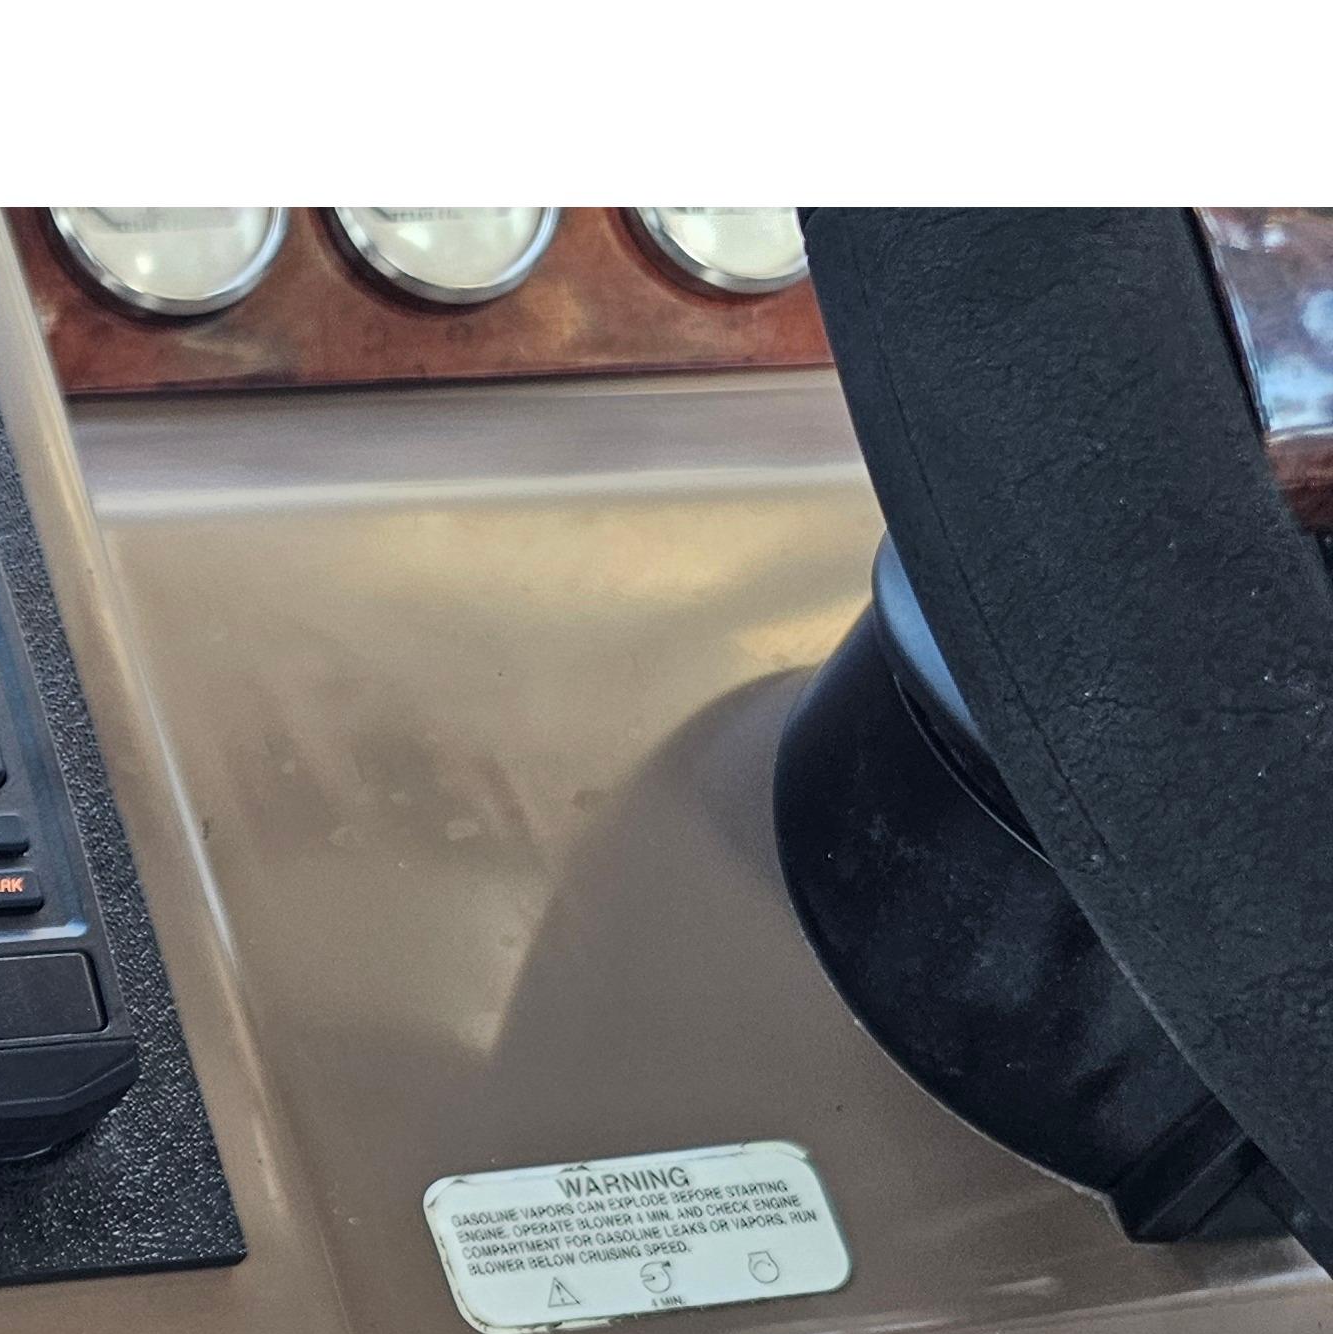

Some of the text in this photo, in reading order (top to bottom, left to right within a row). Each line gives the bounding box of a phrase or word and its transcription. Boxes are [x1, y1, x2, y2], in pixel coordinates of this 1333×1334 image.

[451, 1180, 788, 1228] GASOLINE VAPORS CAN EXPLODE BEFORE STARTING
[555, 1166, 691, 1198] WARNING
[462, 1237, 561, 1260] COMPARTMENT
[565, 1232, 592, 1248] FOR
[595, 1226, 661, 1245] GASOLINE
[664, 1221, 707, 1238] LEAKS
[710, 1218, 730, 1233] OR
[791, 1210, 818, 1224] RUN
[512, 1221, 572, 1238] OPERATE
[577, 1214, 632, 1231] BLOWER
[636, 1213, 644, 1224] 4
[677, 1205, 703, 1219] AND
[707, 1200, 752, 1217] CHECK
[755, 1194, 801, 1210] ENGINE
[467, 1240, 691, 1276] BLOWER BELOW CRUISING SPEED.
